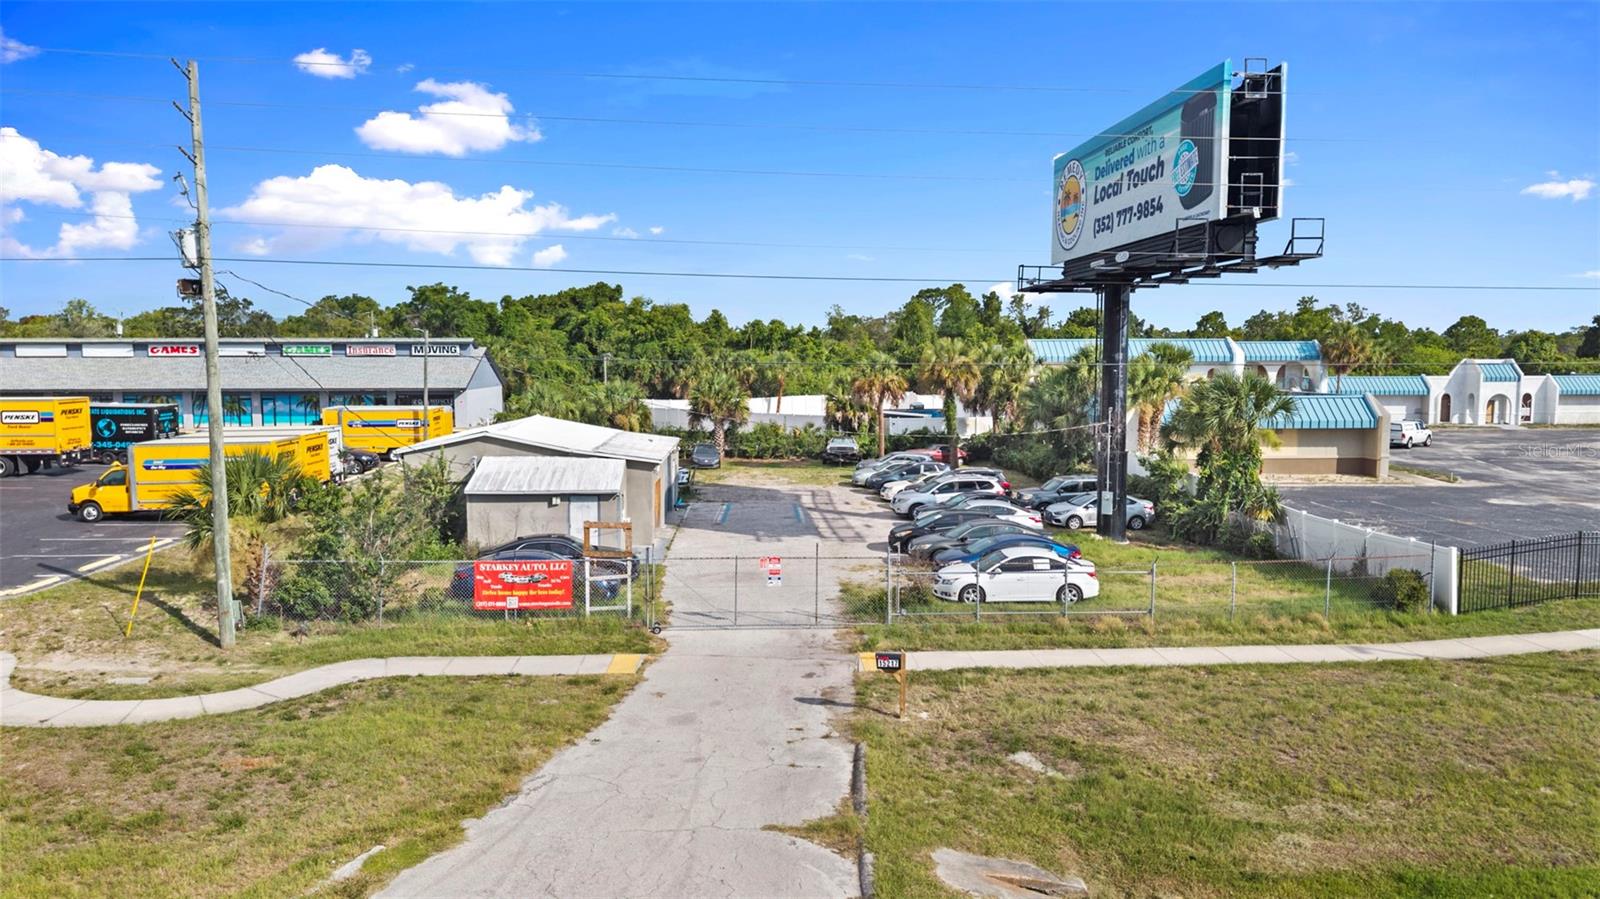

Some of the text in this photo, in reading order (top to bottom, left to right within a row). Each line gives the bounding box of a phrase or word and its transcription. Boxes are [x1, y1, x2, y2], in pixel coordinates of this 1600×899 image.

[1105, 142, 1126, 157] RELIABLE
[1095, 136, 1165, 181] Delivered with a
[1094, 172, 1124, 205] Local
[1126, 155, 1165, 191] Touch
[1093, 212, 1114, 239] (352)
[1116, 195, 1163, 227] 777-9854
[150, 346, 197, 354] GAMES
[348, 345, 394, 354] Insurance
[413, 345, 457, 354] MOVING
